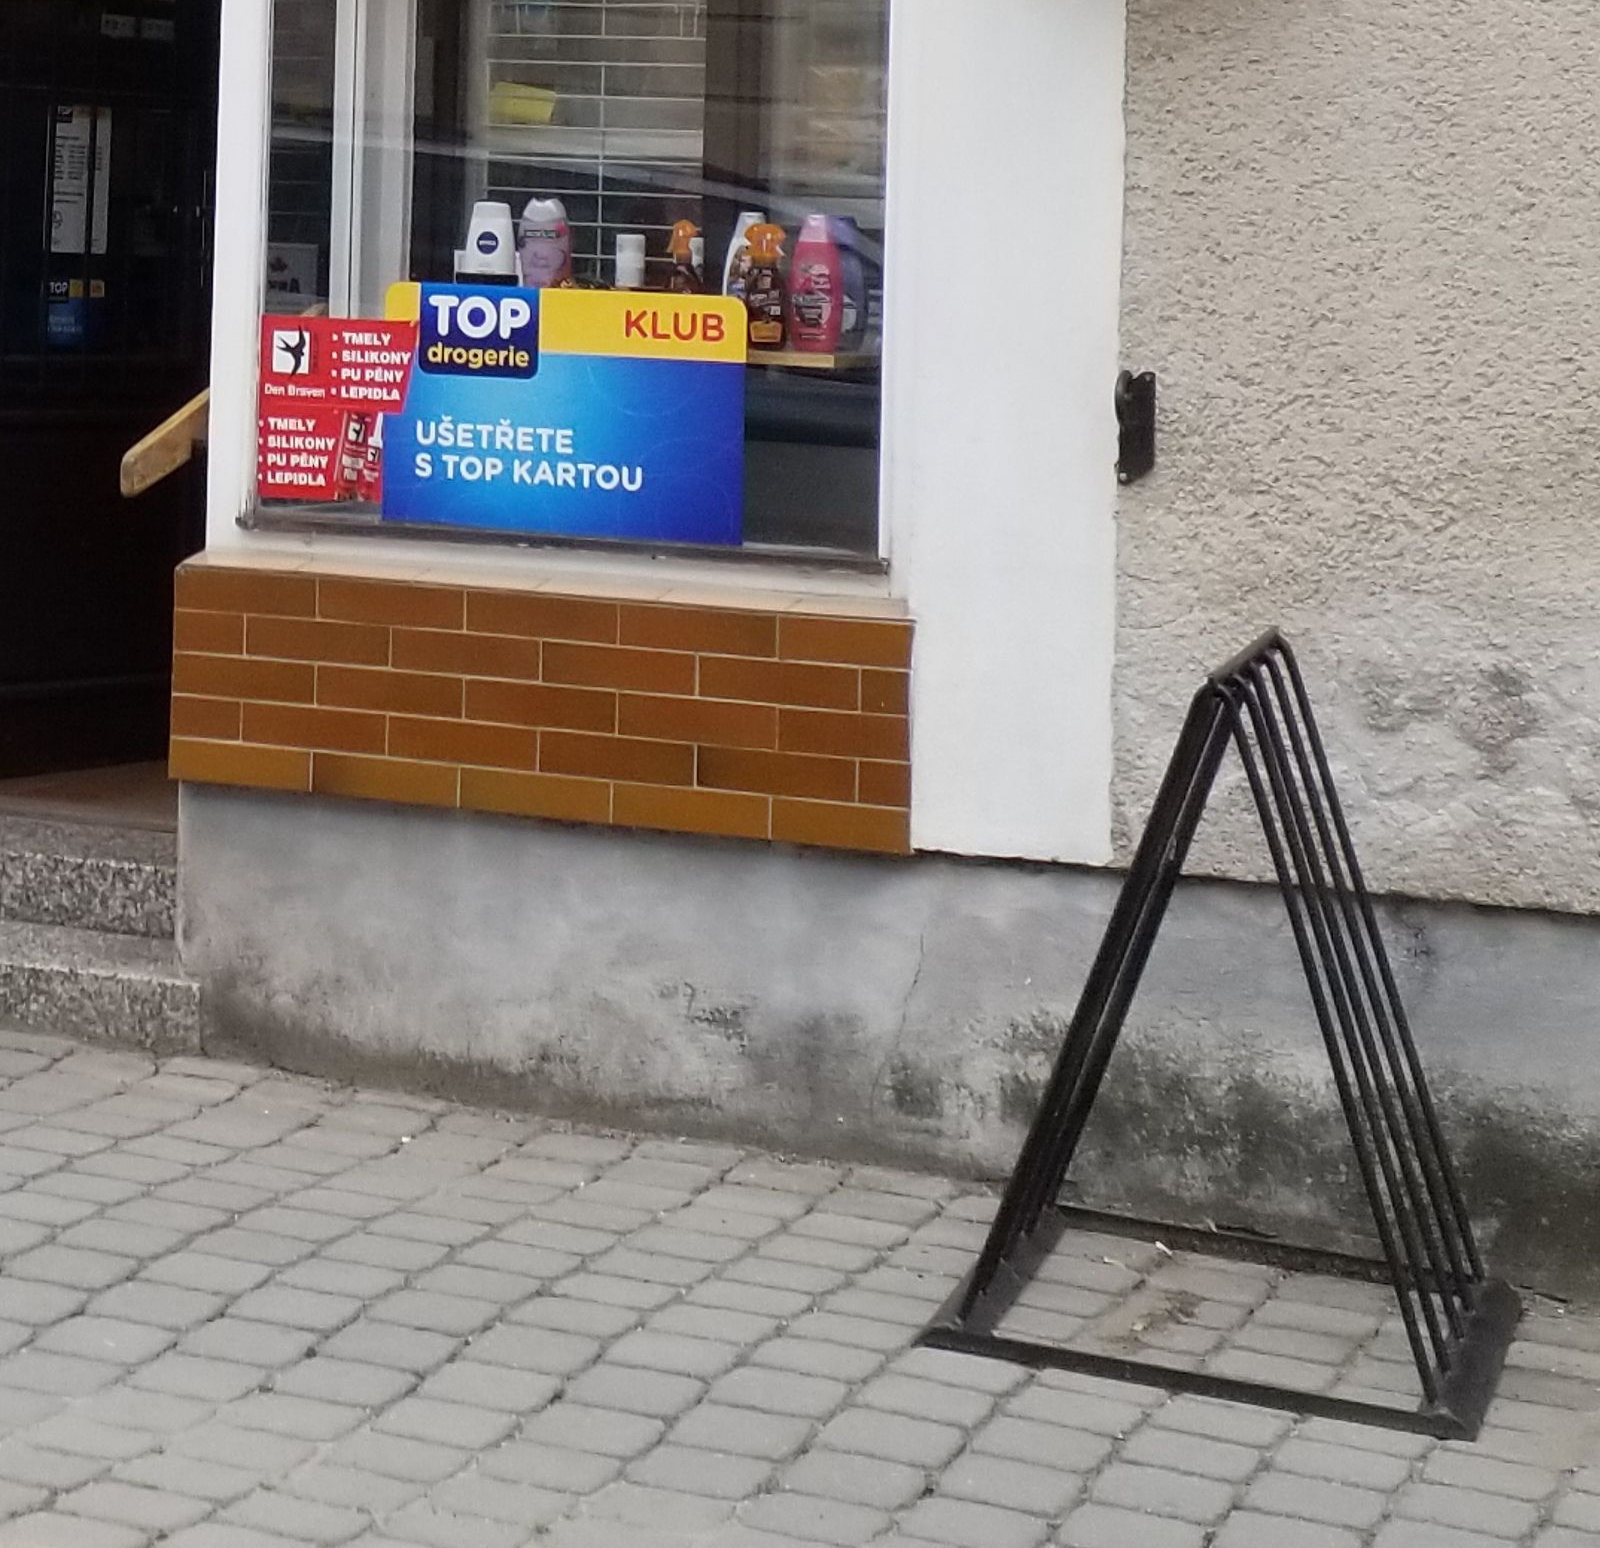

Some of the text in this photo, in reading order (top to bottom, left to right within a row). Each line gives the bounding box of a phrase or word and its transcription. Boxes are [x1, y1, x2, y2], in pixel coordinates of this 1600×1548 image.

[428, 295, 530, 339] TOP
[625, 310, 725, 342] KLUB
[342, 332, 391, 345] TMELY
[342, 350, 411, 365] SILIKONY
[427, 343, 529, 368] drogerie
[341, 368, 361, 381] PU
[341, 386, 400, 401] LEPIDLA
[267, 417, 316, 432] TMELY
[416, 415, 573, 454] UŠETŘETE
[267, 435, 336, 451] SILIKONY
[267, 453, 286, 466] PU
[267, 472, 326, 486] LEPIDLA
[415, 454, 643, 492] S TOP KARTOU
